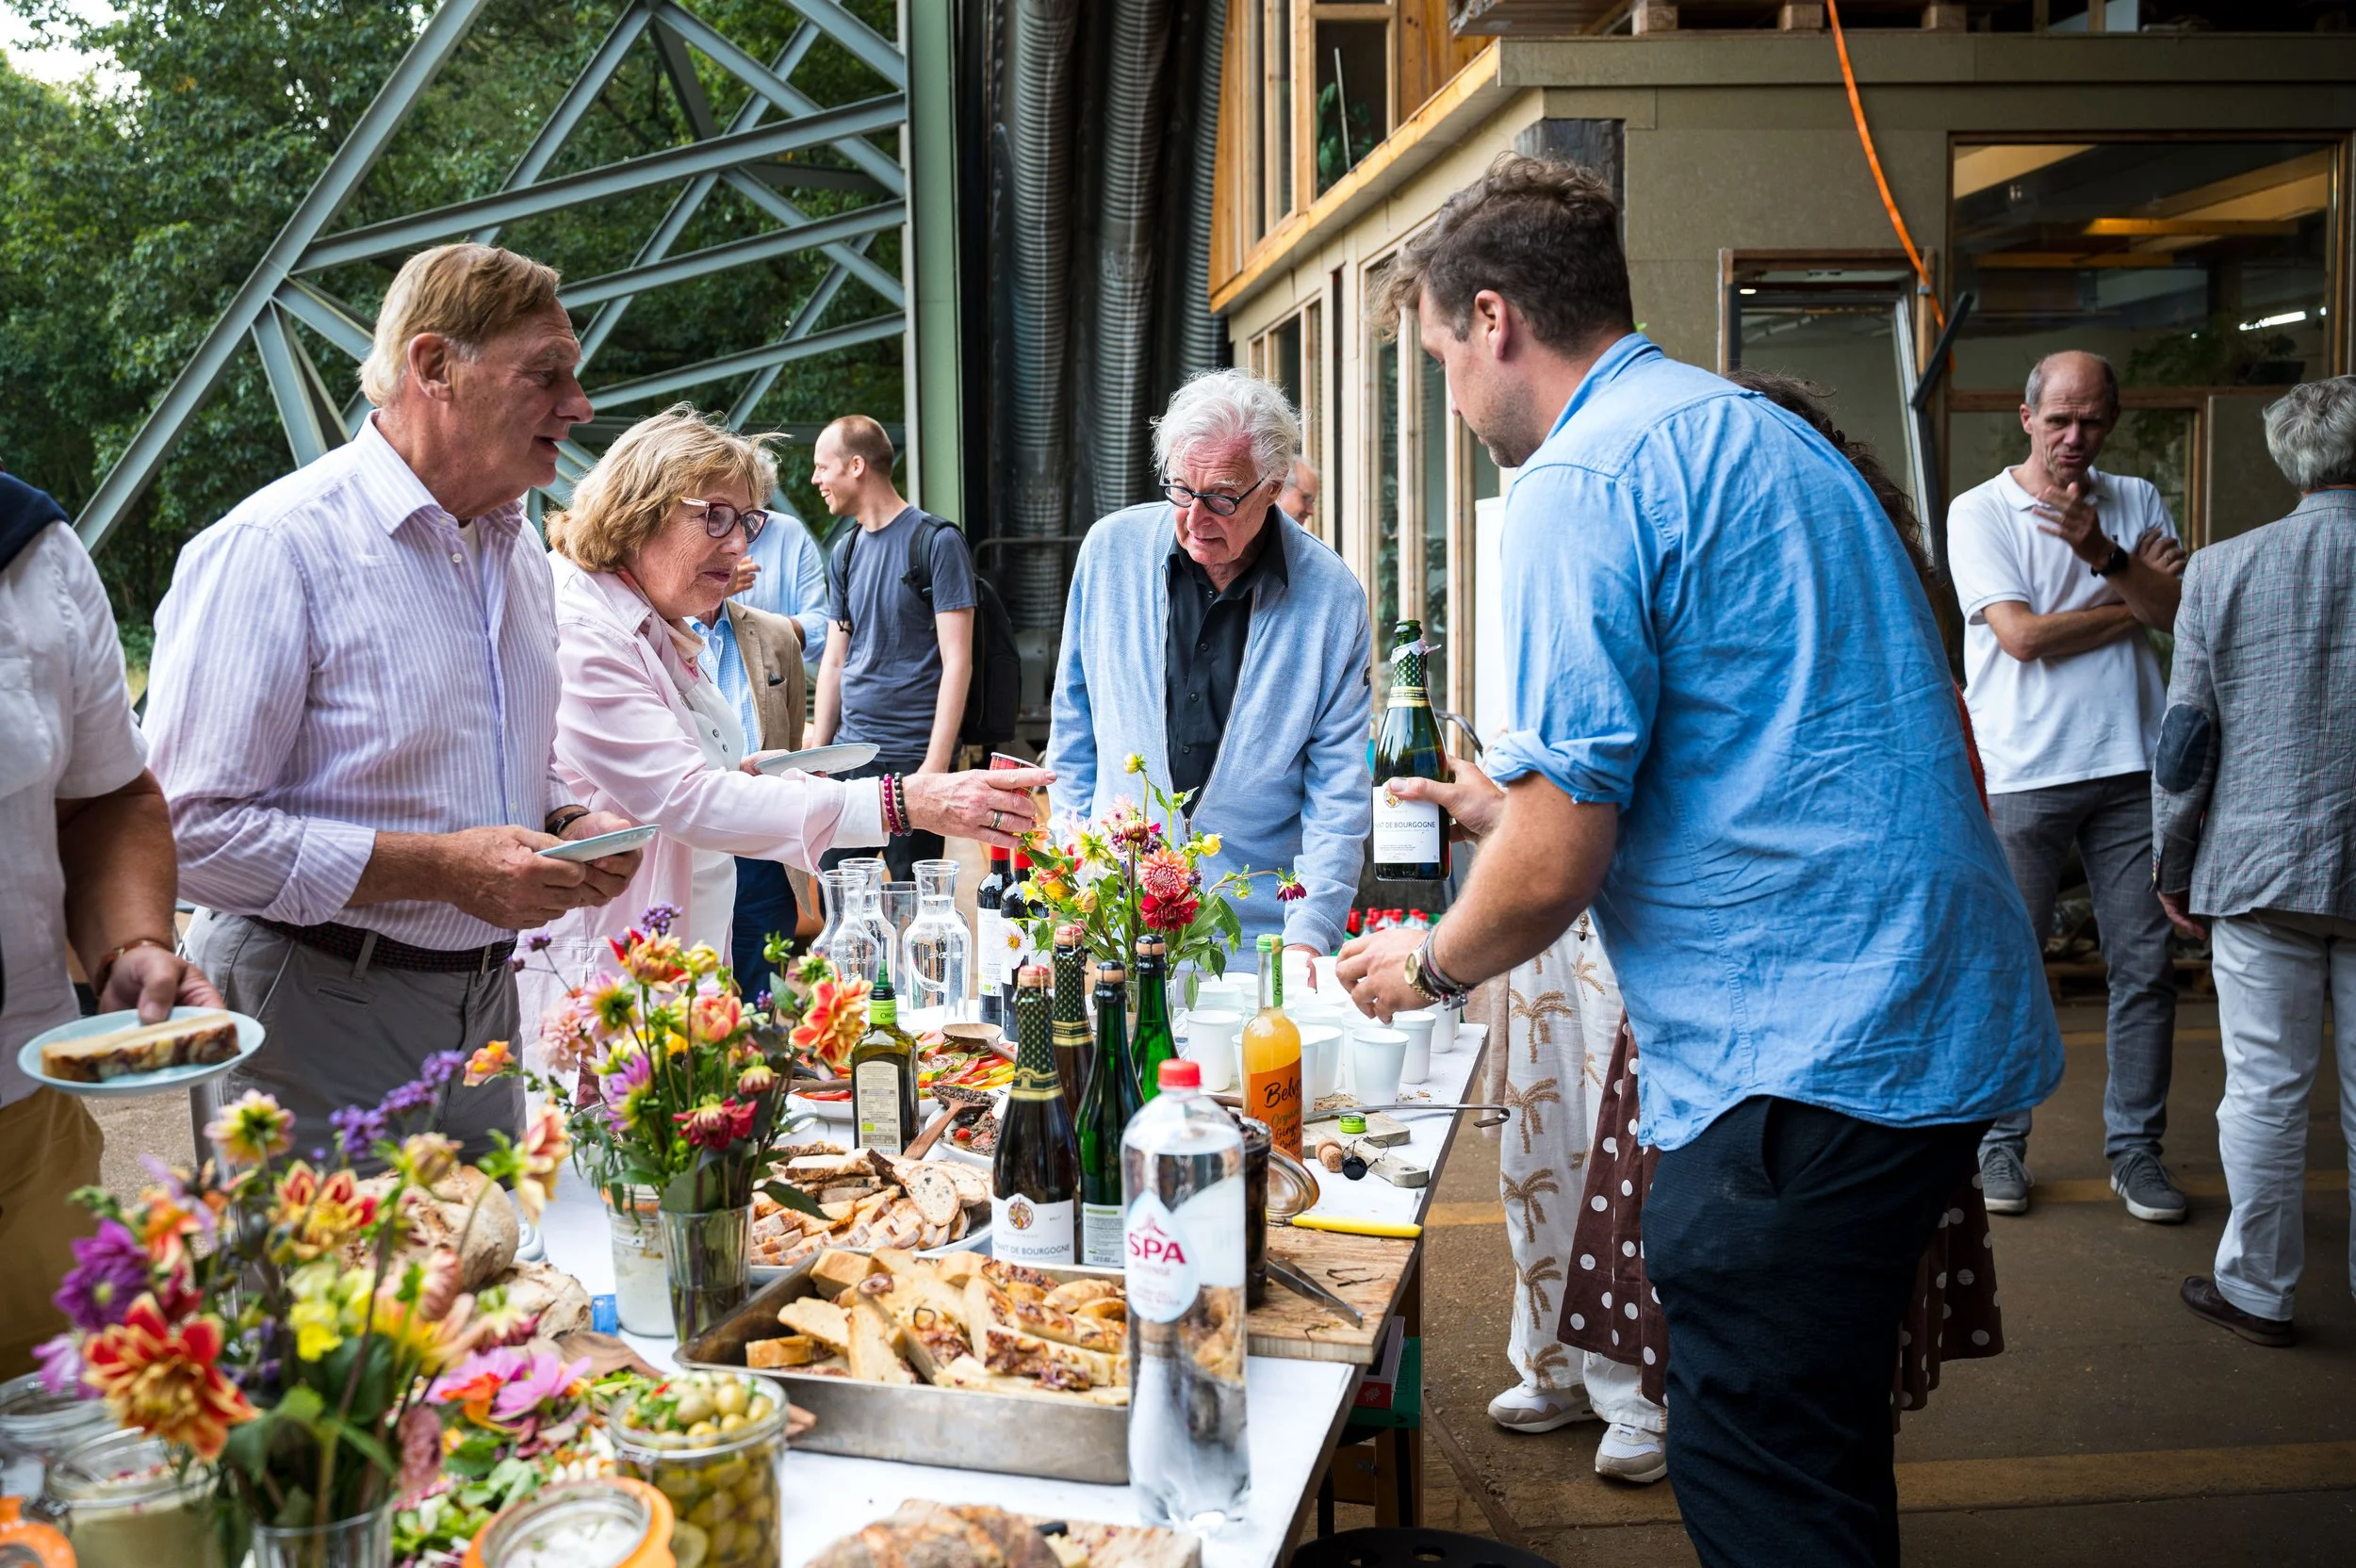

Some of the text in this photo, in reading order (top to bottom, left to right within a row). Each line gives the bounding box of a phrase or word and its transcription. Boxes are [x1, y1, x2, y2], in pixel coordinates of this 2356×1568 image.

[1273, 965, 1283, 996] Organic
[1010, 1245, 1020, 1255] DE
[1021, 1243, 1071, 1256] BOURGOGNE
[1128, 1233, 1186, 1265] SPA
